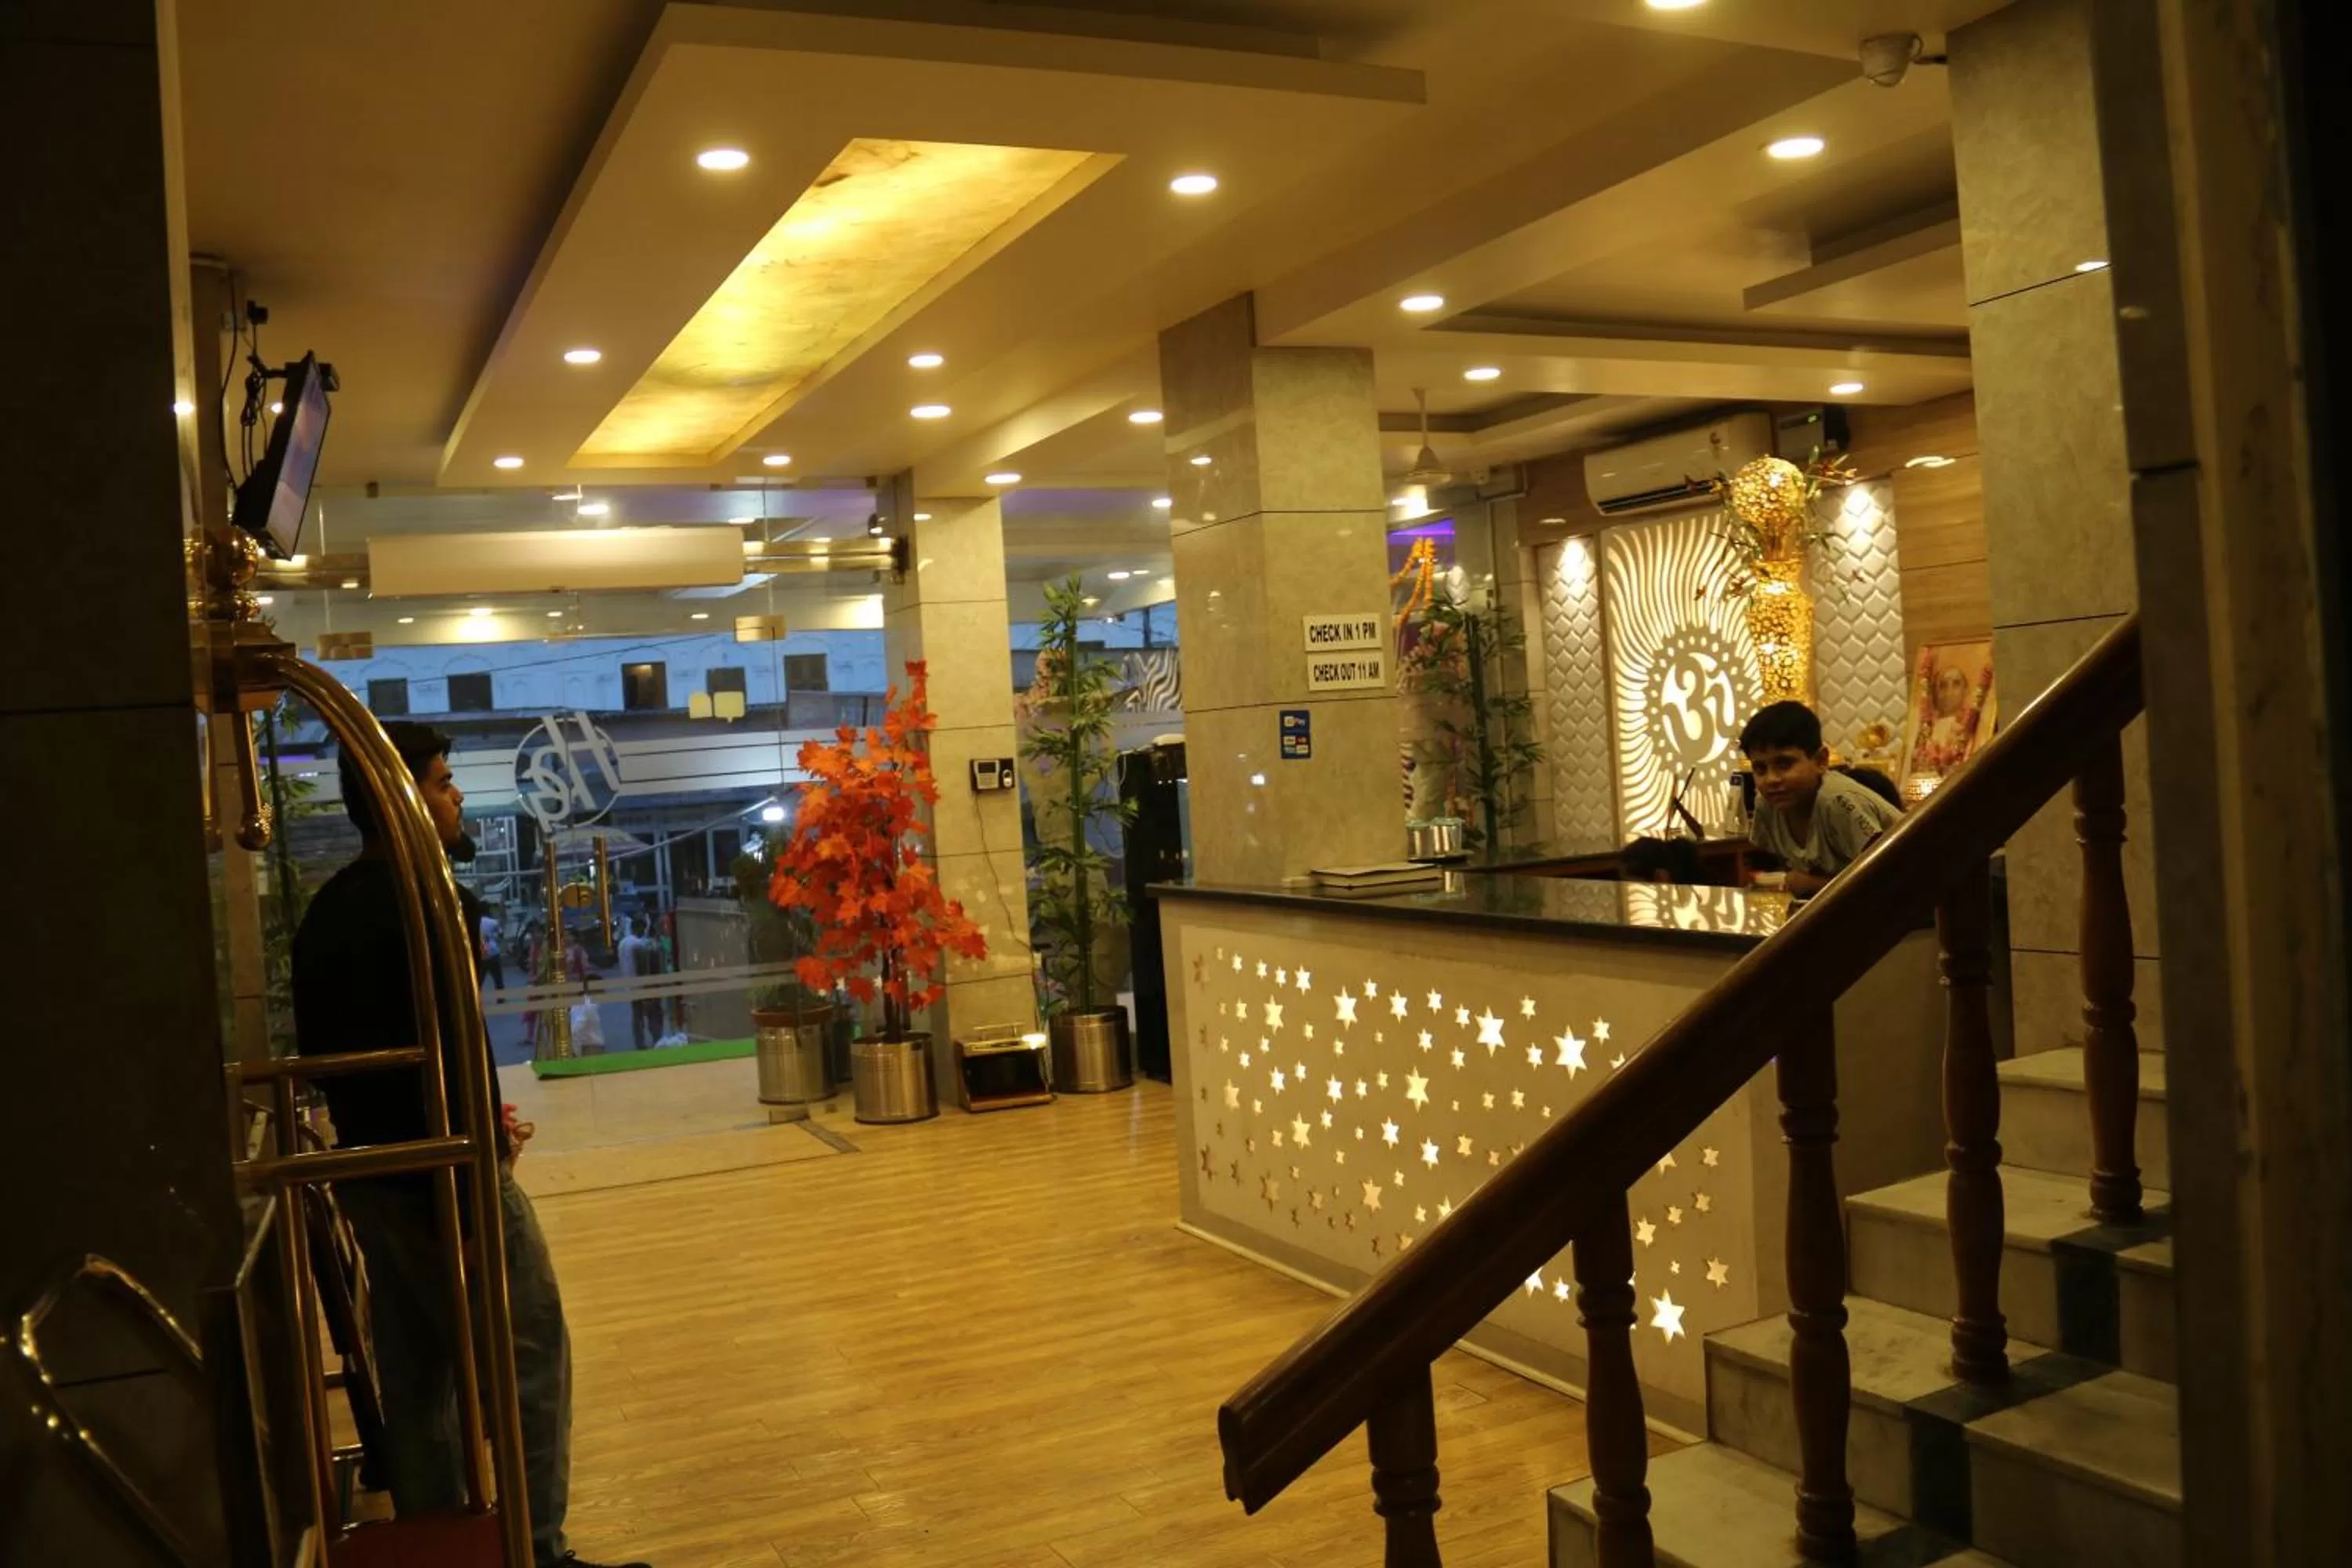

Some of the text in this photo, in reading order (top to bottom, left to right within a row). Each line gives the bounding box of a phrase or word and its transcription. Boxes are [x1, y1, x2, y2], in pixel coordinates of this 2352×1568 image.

[1310, 621, 1377, 643] CHECK IN 1 PM
[1314, 661, 1379, 682] CHECK OUT 11 AM
